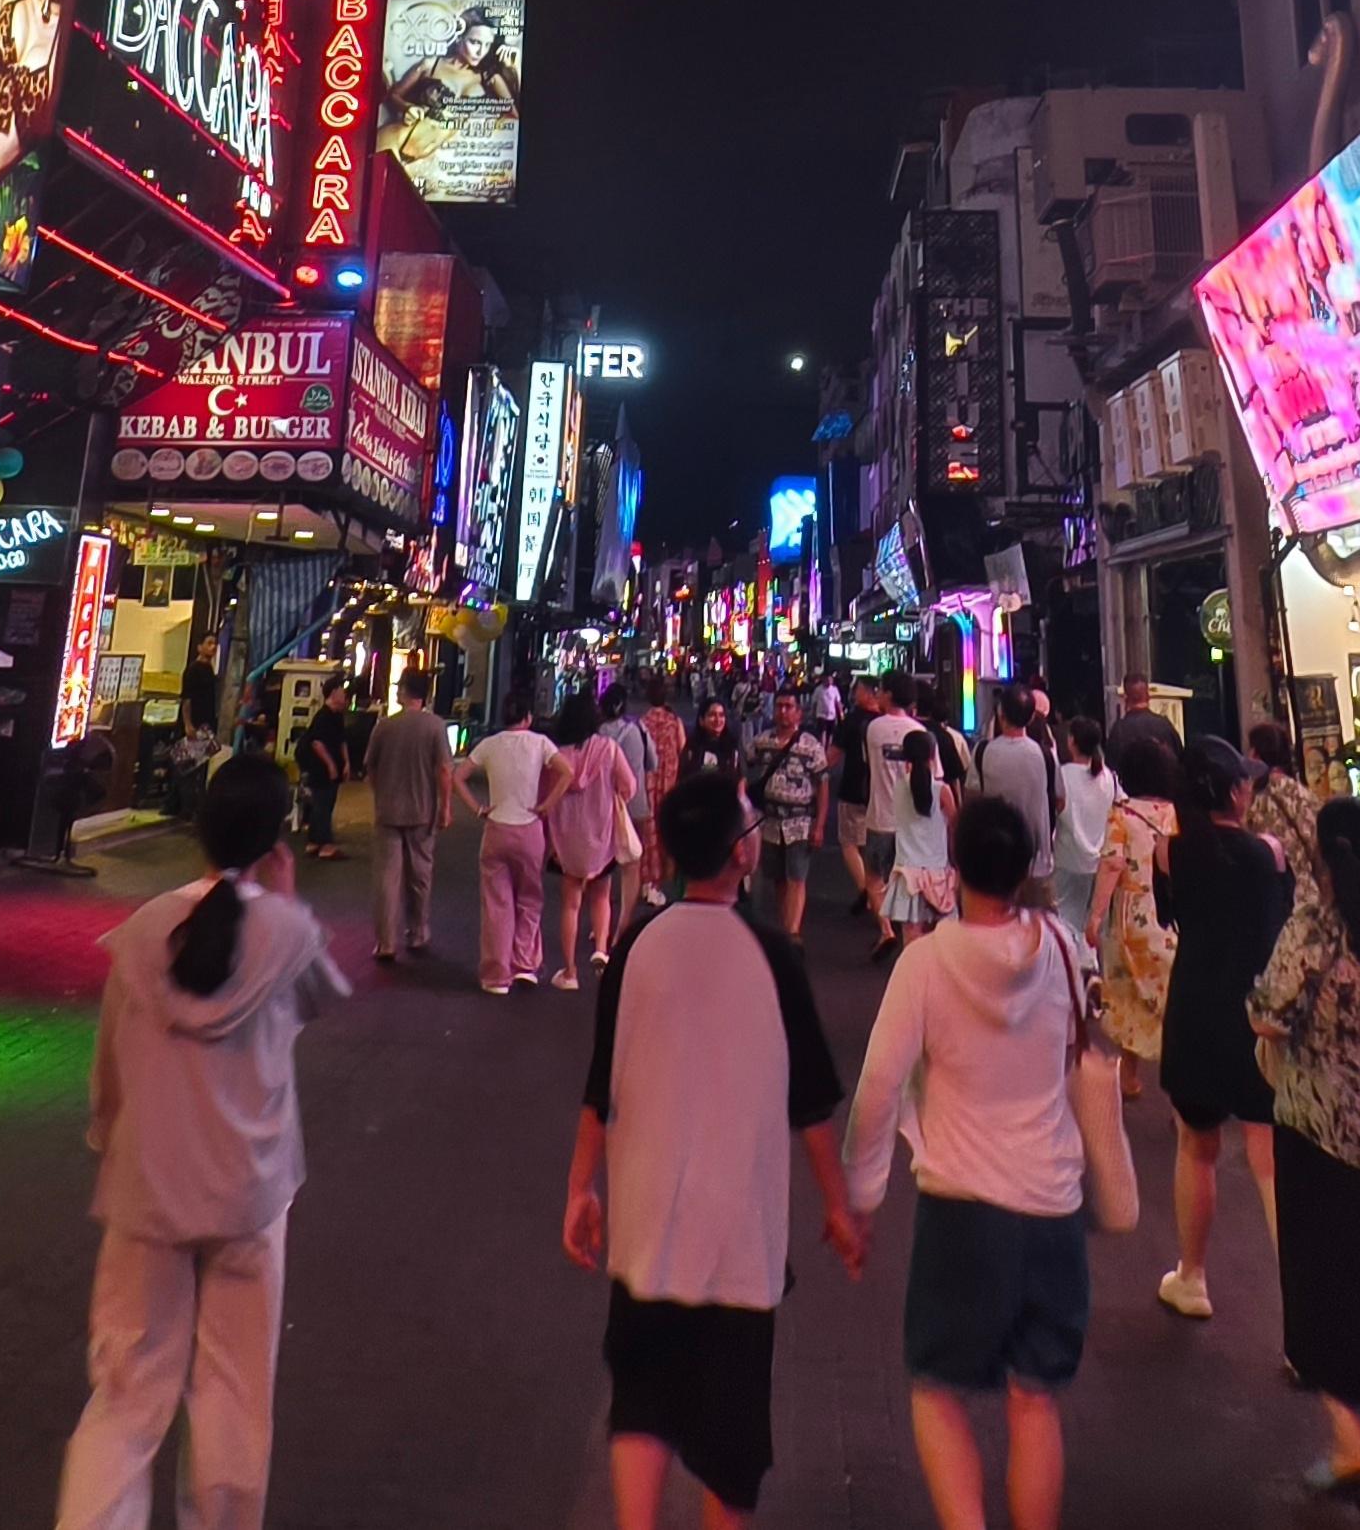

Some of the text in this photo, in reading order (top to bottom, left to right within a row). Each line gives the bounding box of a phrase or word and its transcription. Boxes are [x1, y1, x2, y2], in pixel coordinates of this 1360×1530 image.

[177, 374, 283, 385] WALKING STREET
[351, 337, 399, 418] ISTANBUL
[119, 415, 197, 439] KEBAB
[205, 415, 225, 439] &
